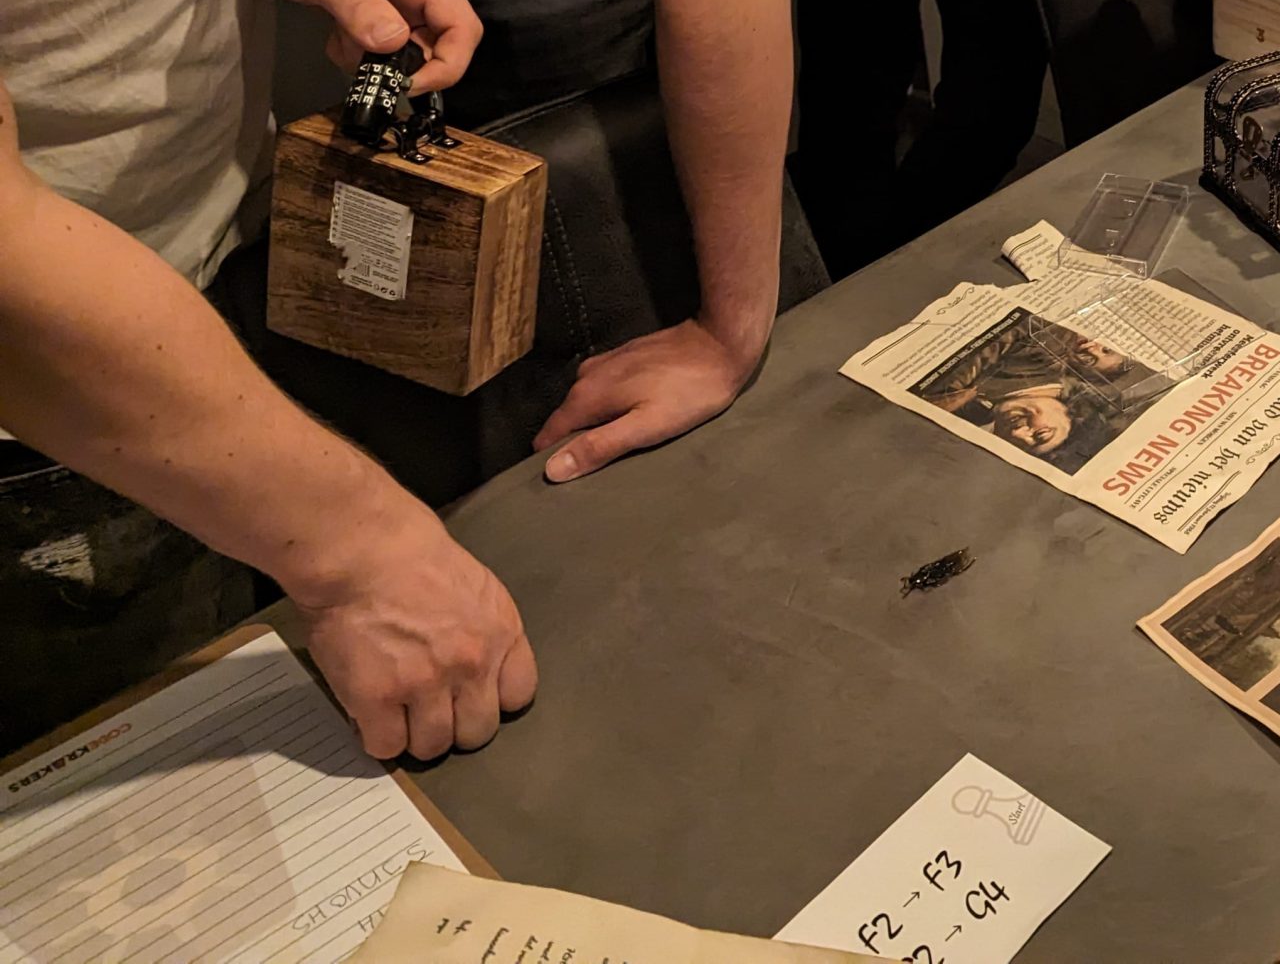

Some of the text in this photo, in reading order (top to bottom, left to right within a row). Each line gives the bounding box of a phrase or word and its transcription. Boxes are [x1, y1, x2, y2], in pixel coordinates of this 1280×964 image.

[1231, 417, 1270, 447] van
[1100, 432, 1180, 498] NEWS
[1203, 445, 1242, 473] het
[1149, 468, 1217, 527] nieuws
[858, 850, 962, 954] F2 F3
[902, 945, 945, 964] 2
